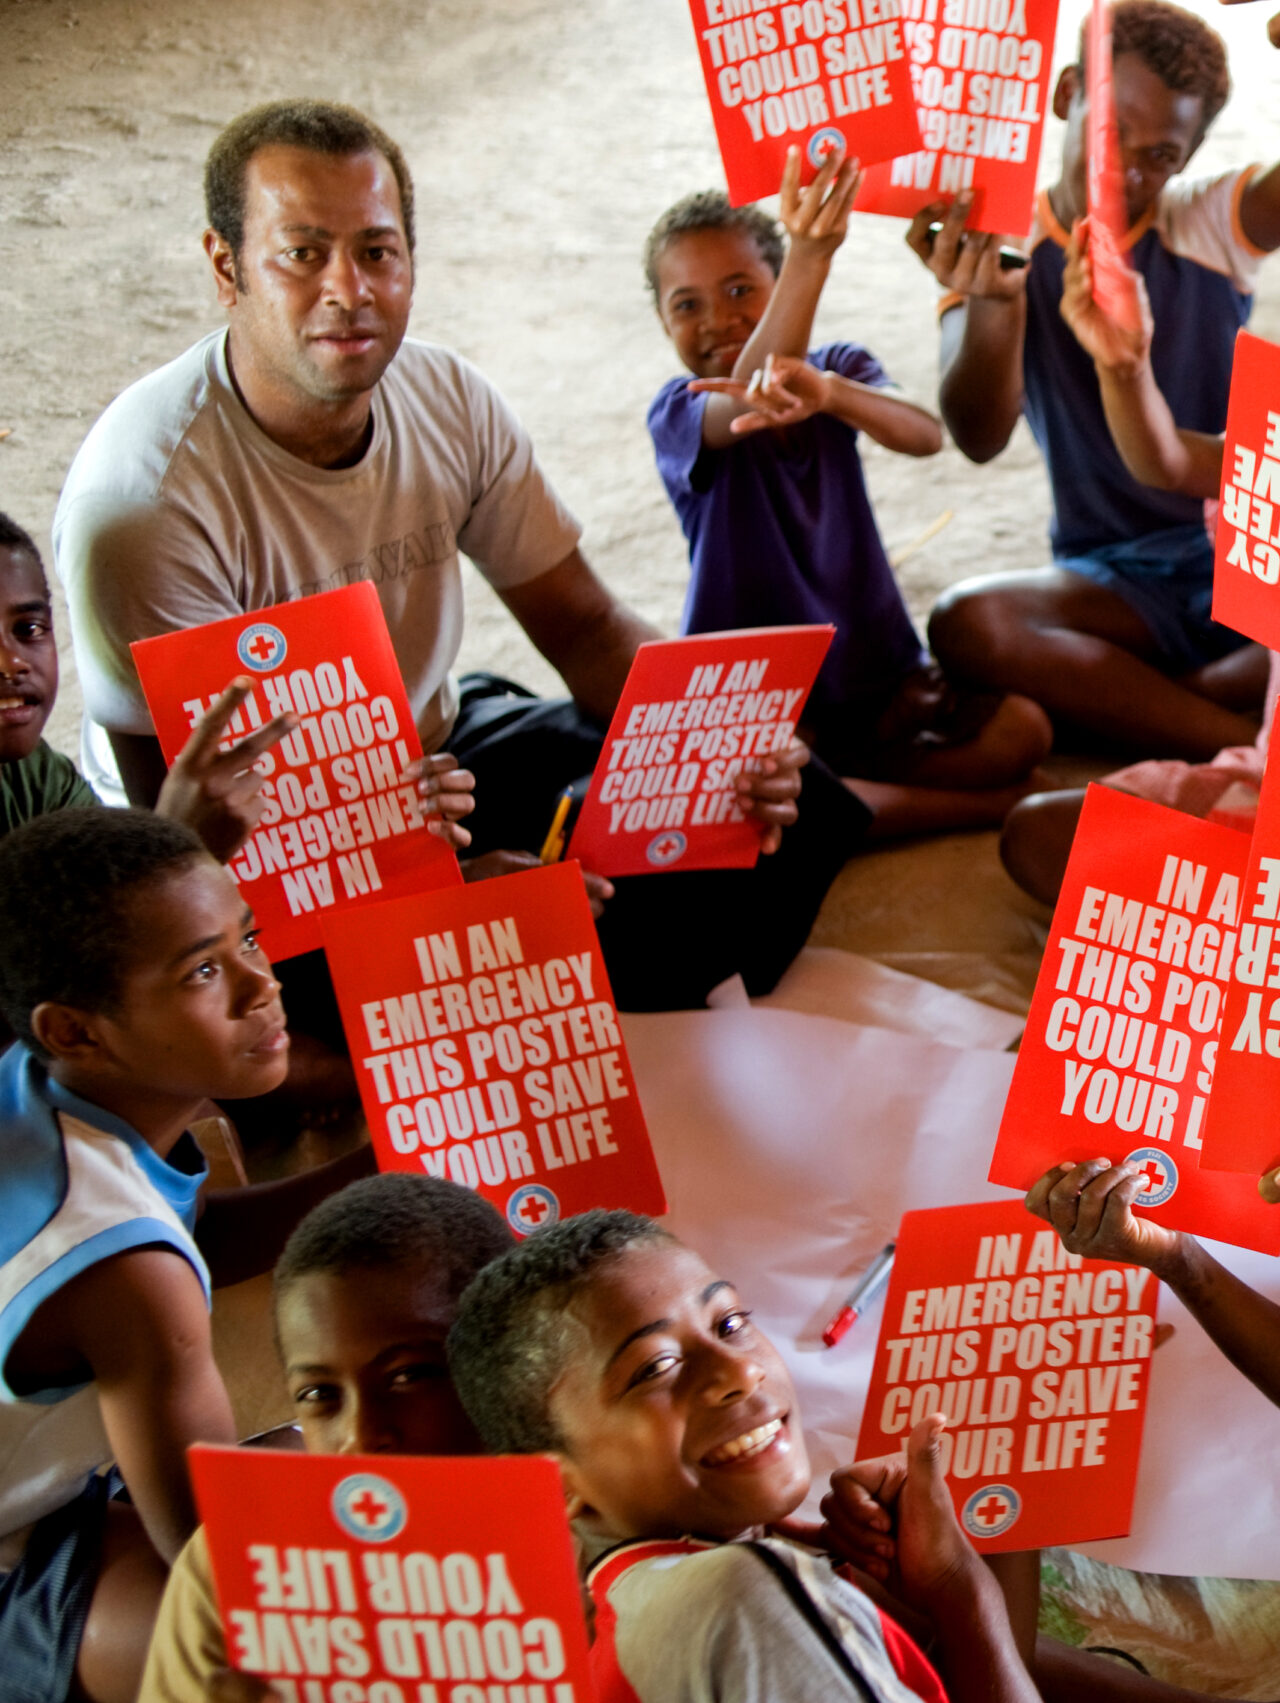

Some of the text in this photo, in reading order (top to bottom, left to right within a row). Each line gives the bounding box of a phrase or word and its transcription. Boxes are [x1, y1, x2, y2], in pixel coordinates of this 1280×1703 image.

[702, 11, 779, 68] THIS
[718, 43, 820, 107] COULD
[822, 21, 904, 76] SAVE
[937, 27, 1042, 80] COULD
[742, 84, 829, 142] YOUR
[829, 66, 892, 118] LIFE
[967, 74, 1040, 123] THIS
[891, 151, 975, 193] IN AN
[262, 656, 368, 717] YOUR
[623, 687, 804, 736] EMERGENCY
[685, 658, 769, 698] IN AN
[280, 695, 399, 767] COULD
[608, 721, 795, 771] THIS POSTER
[599, 762, 700, 804] COULD
[609, 796, 688, 835] YOUR
[281, 847, 383, 917] IN AN
[1156, 854, 1207, 915] IN
[413, 916, 524, 984] IN AN
[1055, 937, 1156, 1013] THIS
[361, 951, 595, 1052] EMERGENCY
[363, 1001, 621, 1104] THIS POSTER
[1045, 997, 1191, 1083] COULD
[385, 1051, 629, 1154] COULD SAVE
[1060, 1059, 1179, 1142] YOUR
[420, 1107, 619, 1190] YOUR LIFE
[975, 1234, 1022, 1278] IN
[900, 1267, 1151, 1334] EMERGENCY
[886, 1314, 1152, 1384] THIS POSTER
[879, 1364, 1142, 1434] COULD SAVE
[1022, 1417, 1108, 1473] LIFE
[247, 1544, 524, 1616] YOUR LIFE
[230, 1609, 566, 1681] COULD SAVE
